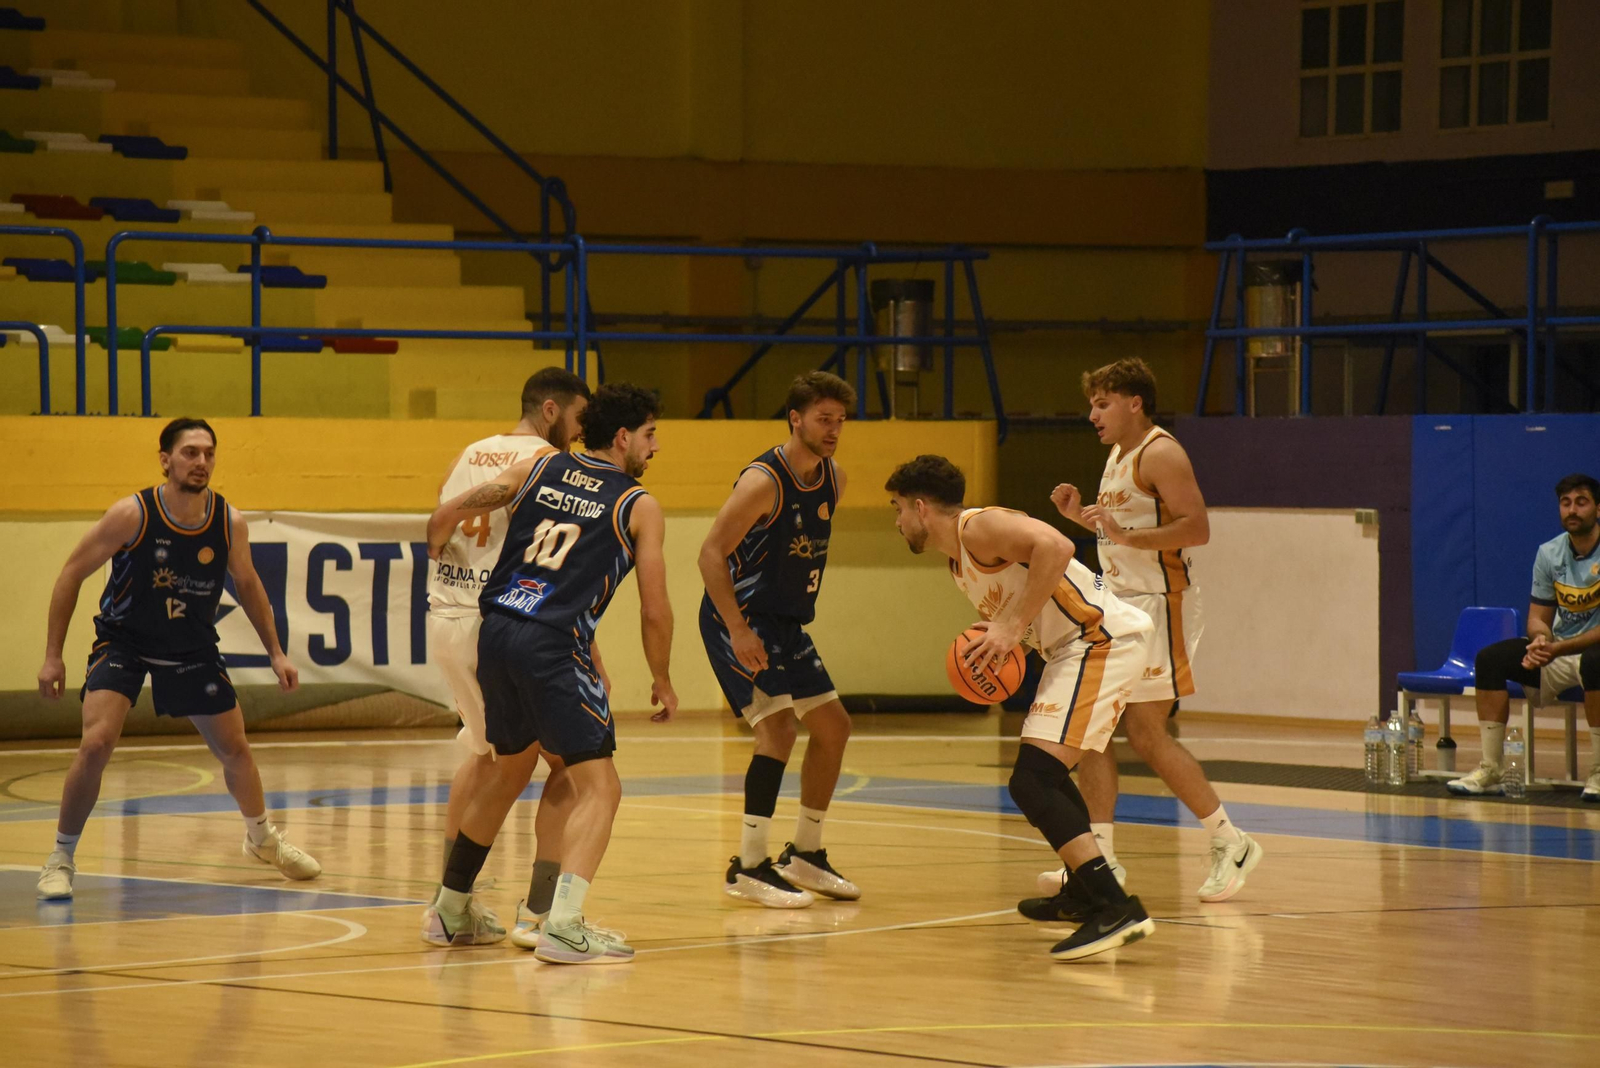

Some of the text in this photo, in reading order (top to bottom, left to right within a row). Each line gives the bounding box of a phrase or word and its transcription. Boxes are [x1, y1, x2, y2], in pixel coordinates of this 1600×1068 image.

[562, 469, 604, 492] LÓPEZ
[561, 494, 606, 519] STROG
[461, 512, 491, 547] 4
[522, 517, 582, 572] 10
[807, 569, 820, 593] 3
[165, 597, 187, 620] 12
[497, 588, 541, 613] UBAGO
